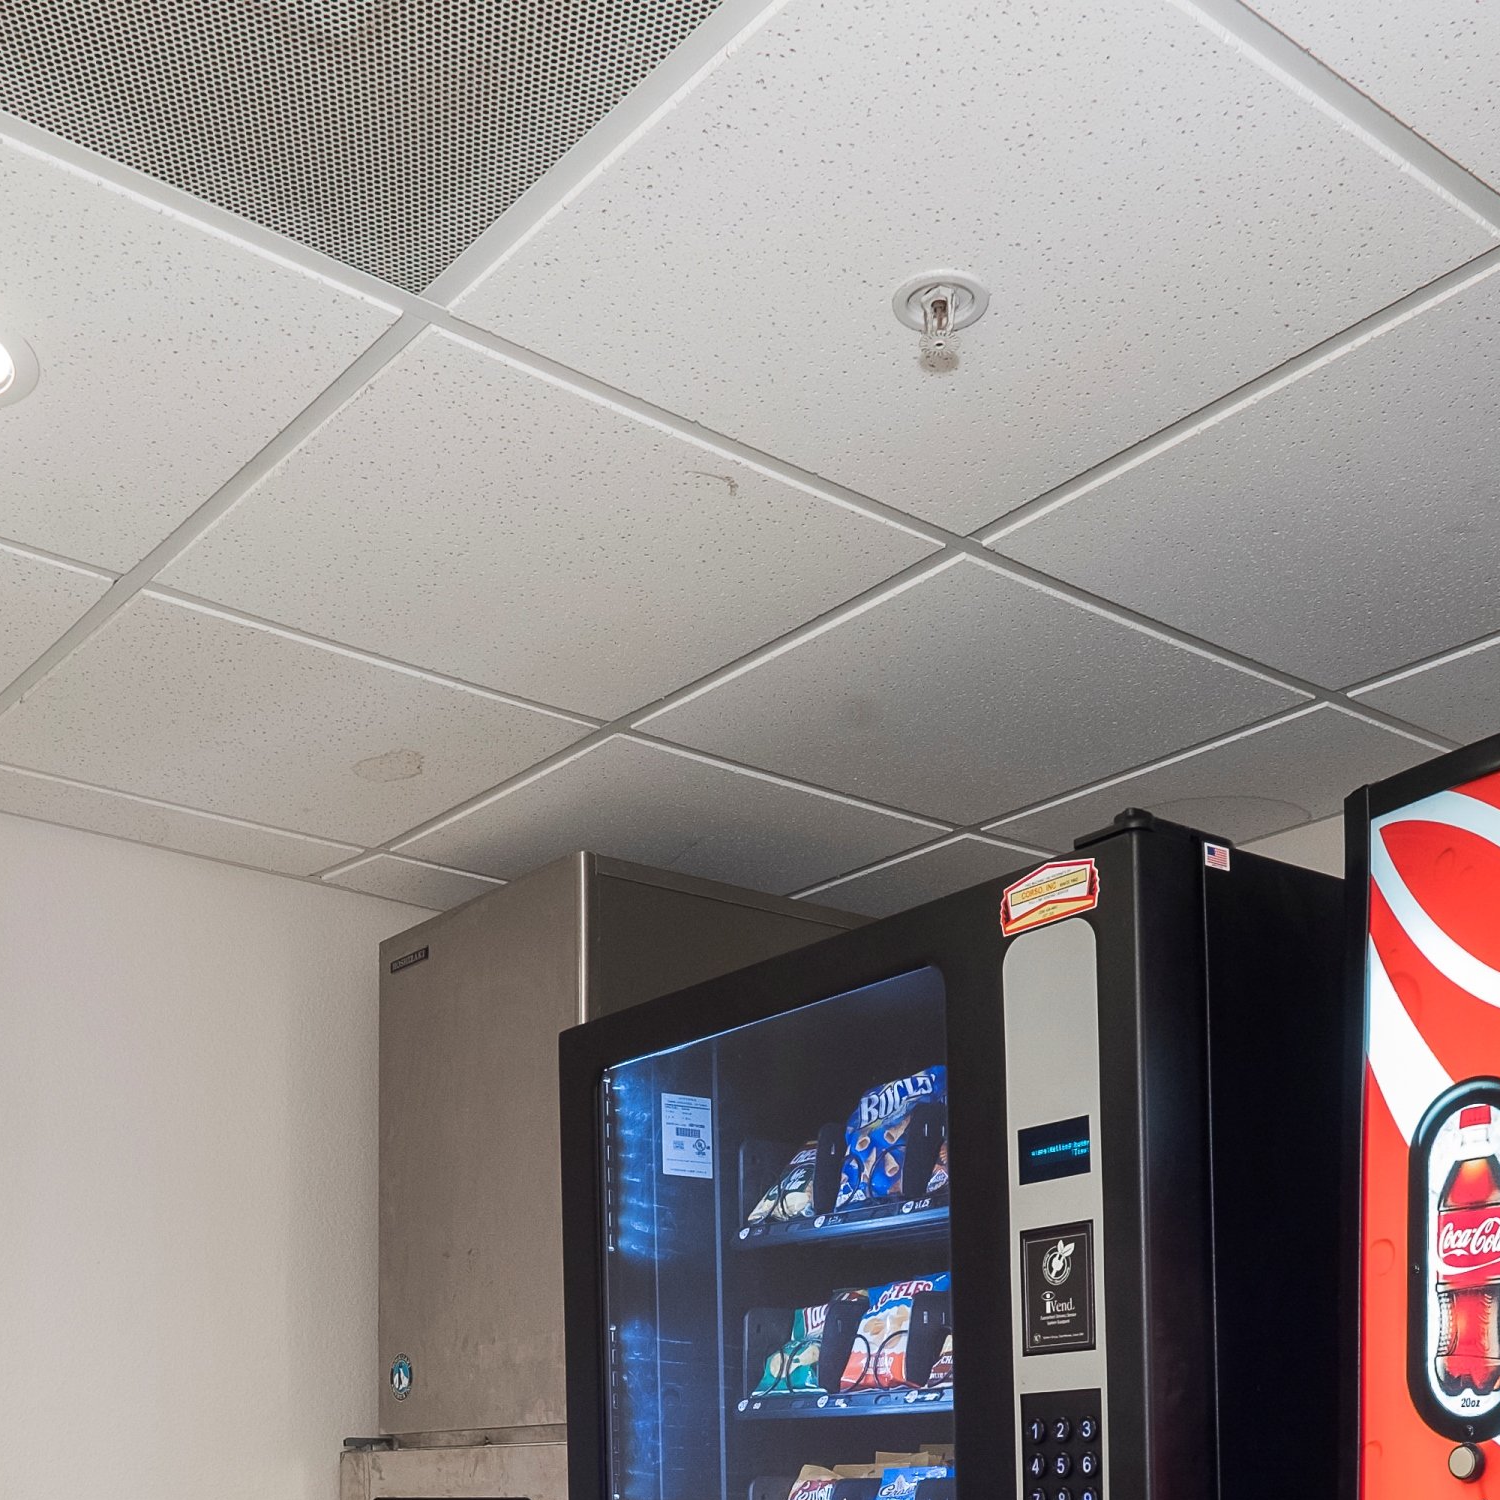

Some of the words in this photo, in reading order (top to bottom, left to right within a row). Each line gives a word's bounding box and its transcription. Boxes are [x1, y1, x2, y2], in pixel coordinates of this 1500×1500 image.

[1460, 1396, 1480, 1409] 20oz
[1031, 1423, 1038, 1439] 1
[1057, 1422, 1064, 1438] 2
[1082, 1421, 1091, 1437] 3
[1031, 1458, 1040, 1475] 4
[1057, 1458, 1065, 1474] 5
[1082, 1456, 1091, 1473] 6
